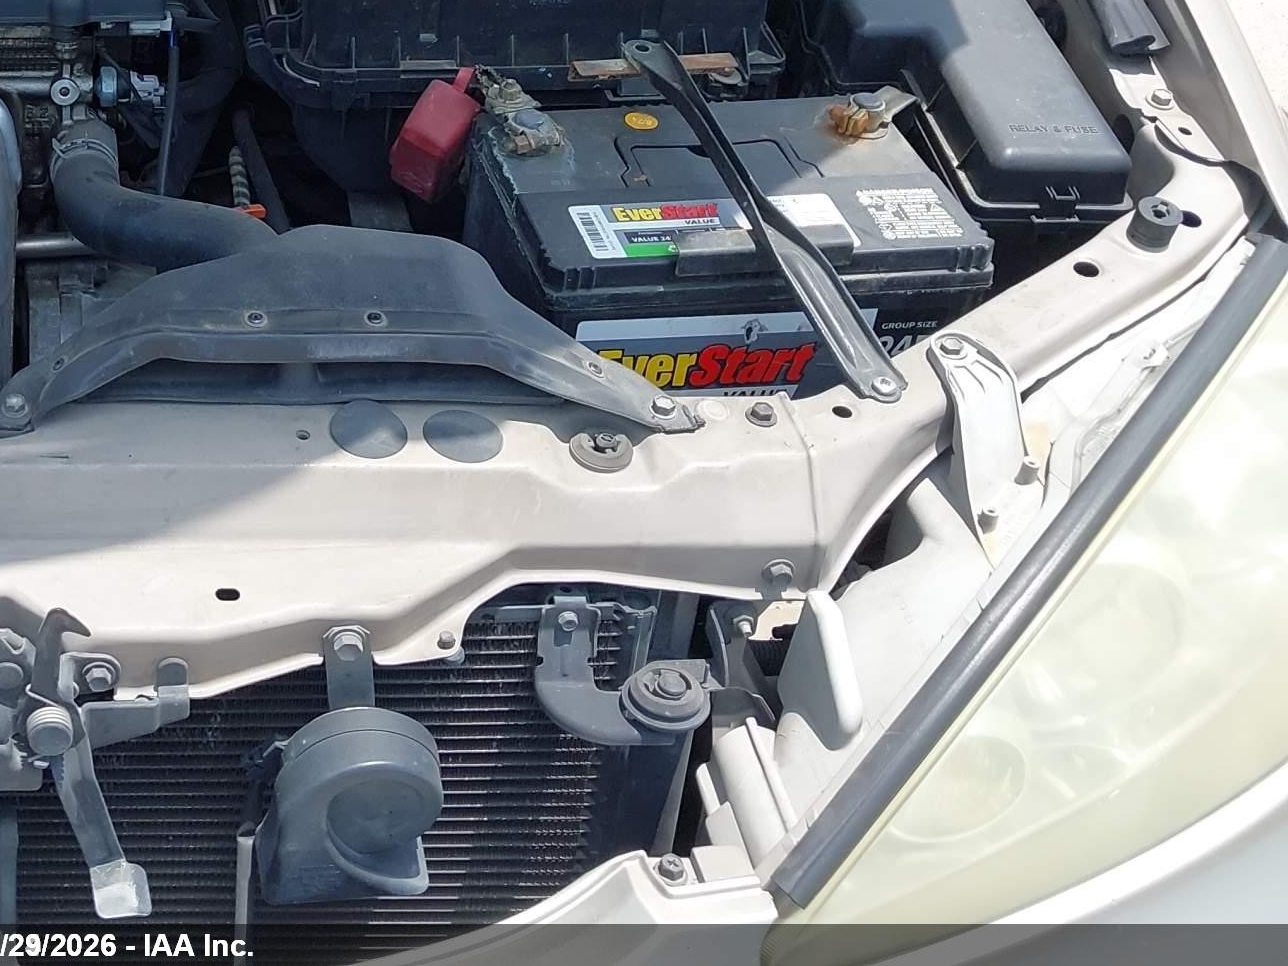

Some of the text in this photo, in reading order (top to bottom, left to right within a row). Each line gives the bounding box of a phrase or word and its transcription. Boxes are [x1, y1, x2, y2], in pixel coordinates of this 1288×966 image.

[1008, 124, 1100, 134] RELAY & FUSE
[611, 202, 719, 222] EverStart
[684, 218, 716, 226] VALUE
[881, 322, 916, 330] GROUP
[879, 334, 931, 357] 24
